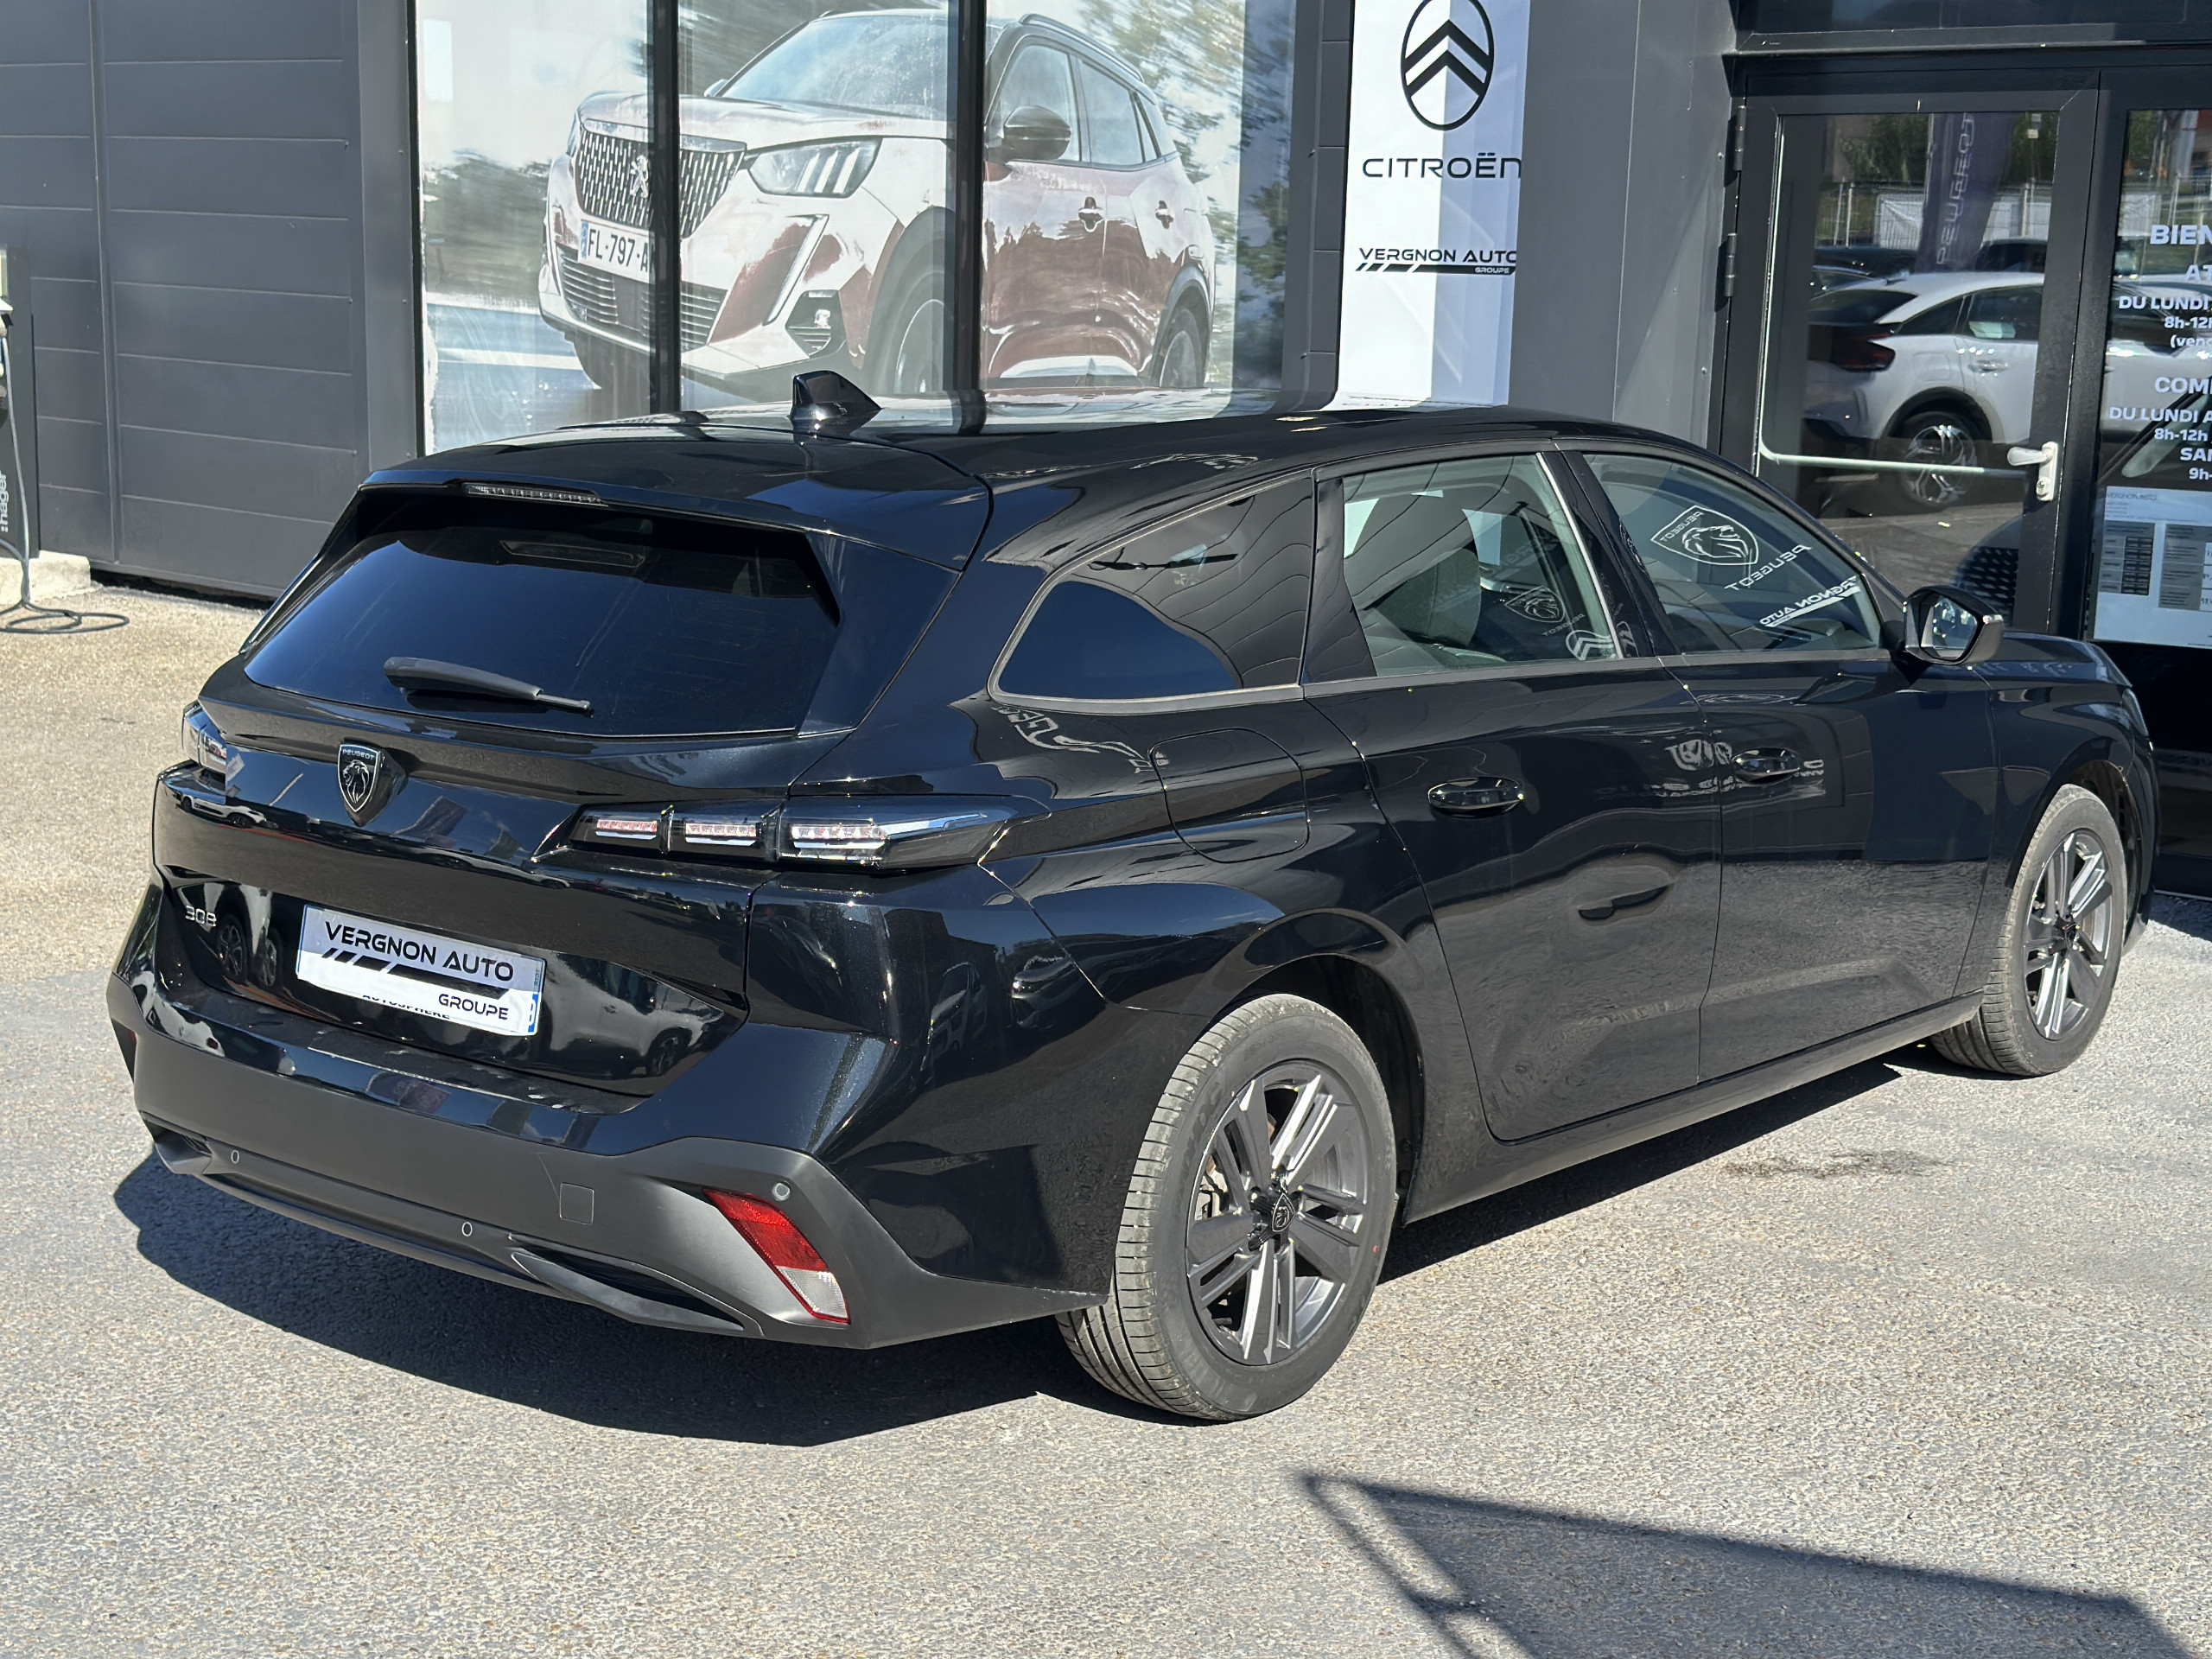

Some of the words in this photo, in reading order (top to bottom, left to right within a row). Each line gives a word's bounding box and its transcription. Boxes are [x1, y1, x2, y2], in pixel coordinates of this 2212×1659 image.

[1362, 152, 1522, 179] CITROËN
[2150, 225, 2212, 245] BIEN
[588, 229, 654, 274] FL-797-A
[1359, 247, 1457, 263] VERGNON
[1462, 250, 1516, 264] AUTO
[2119, 296, 2146, 309] DU
[2151, 296, 2209, 310] LUNDI
[2154, 377, 2212, 394] COM
[2109, 407, 2136, 421] DU
[2141, 408, 2198, 423] LUNDI
[2154, 428, 2208, 442] 8h-12h
[342, 748, 375, 760] PEUGEOT
[185, 905, 217, 927] 308
[325, 921, 437, 965] VERGNON
[442, 950, 514, 982] AUTO
[438, 994, 510, 1020] GROUPE
